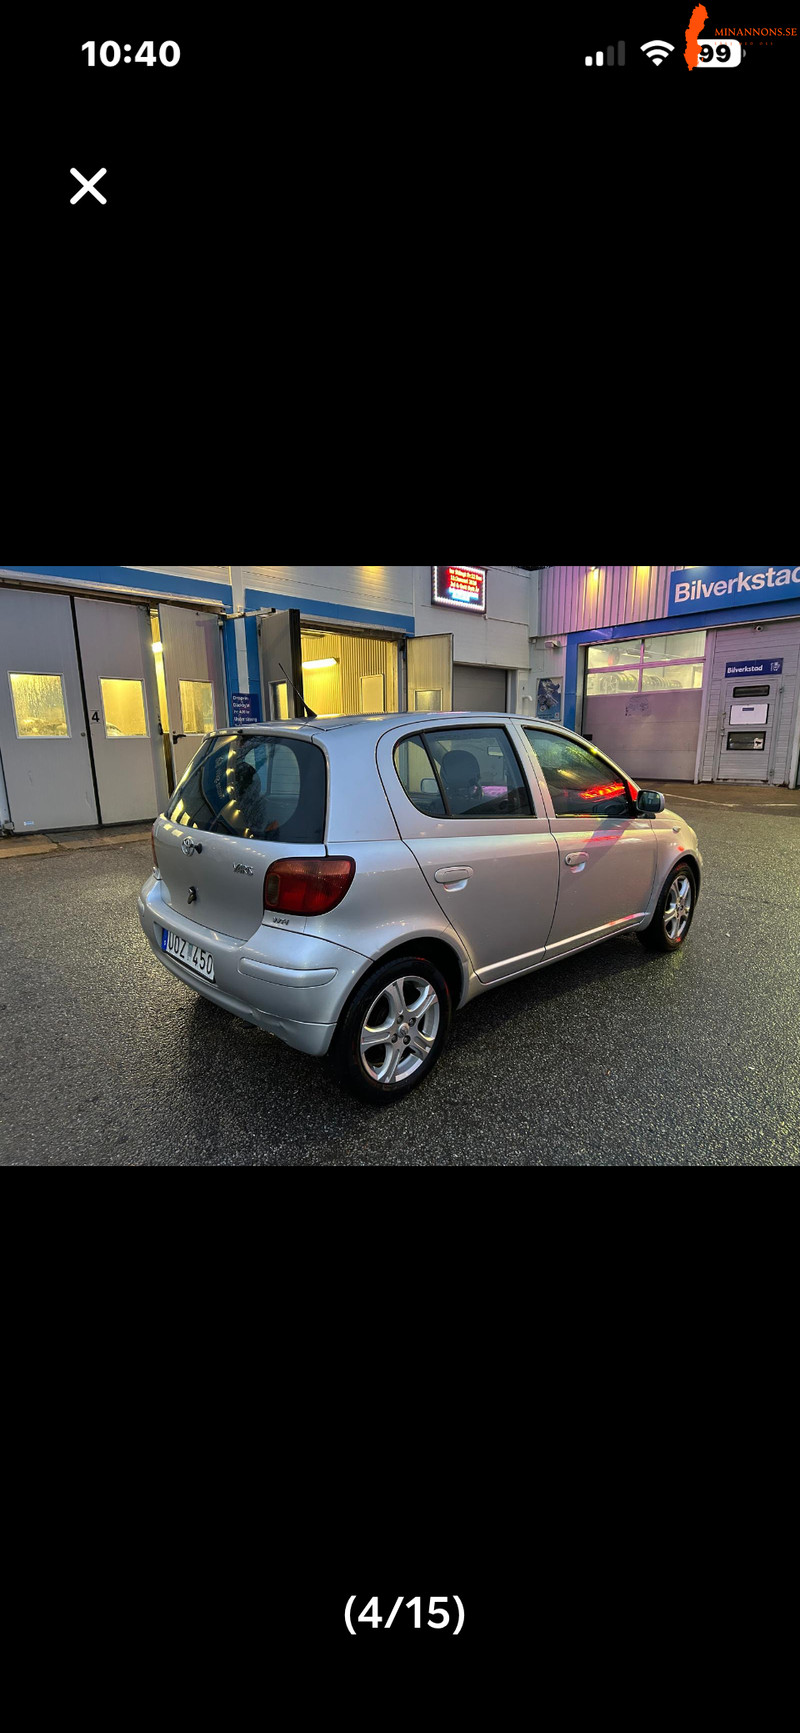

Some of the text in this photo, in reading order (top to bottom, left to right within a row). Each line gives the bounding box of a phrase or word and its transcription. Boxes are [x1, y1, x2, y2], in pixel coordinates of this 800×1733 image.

[727, 665, 763, 674] Bilverkstad
[91, 711, 100, 723] 4
[192, 946, 214, 975] 450
